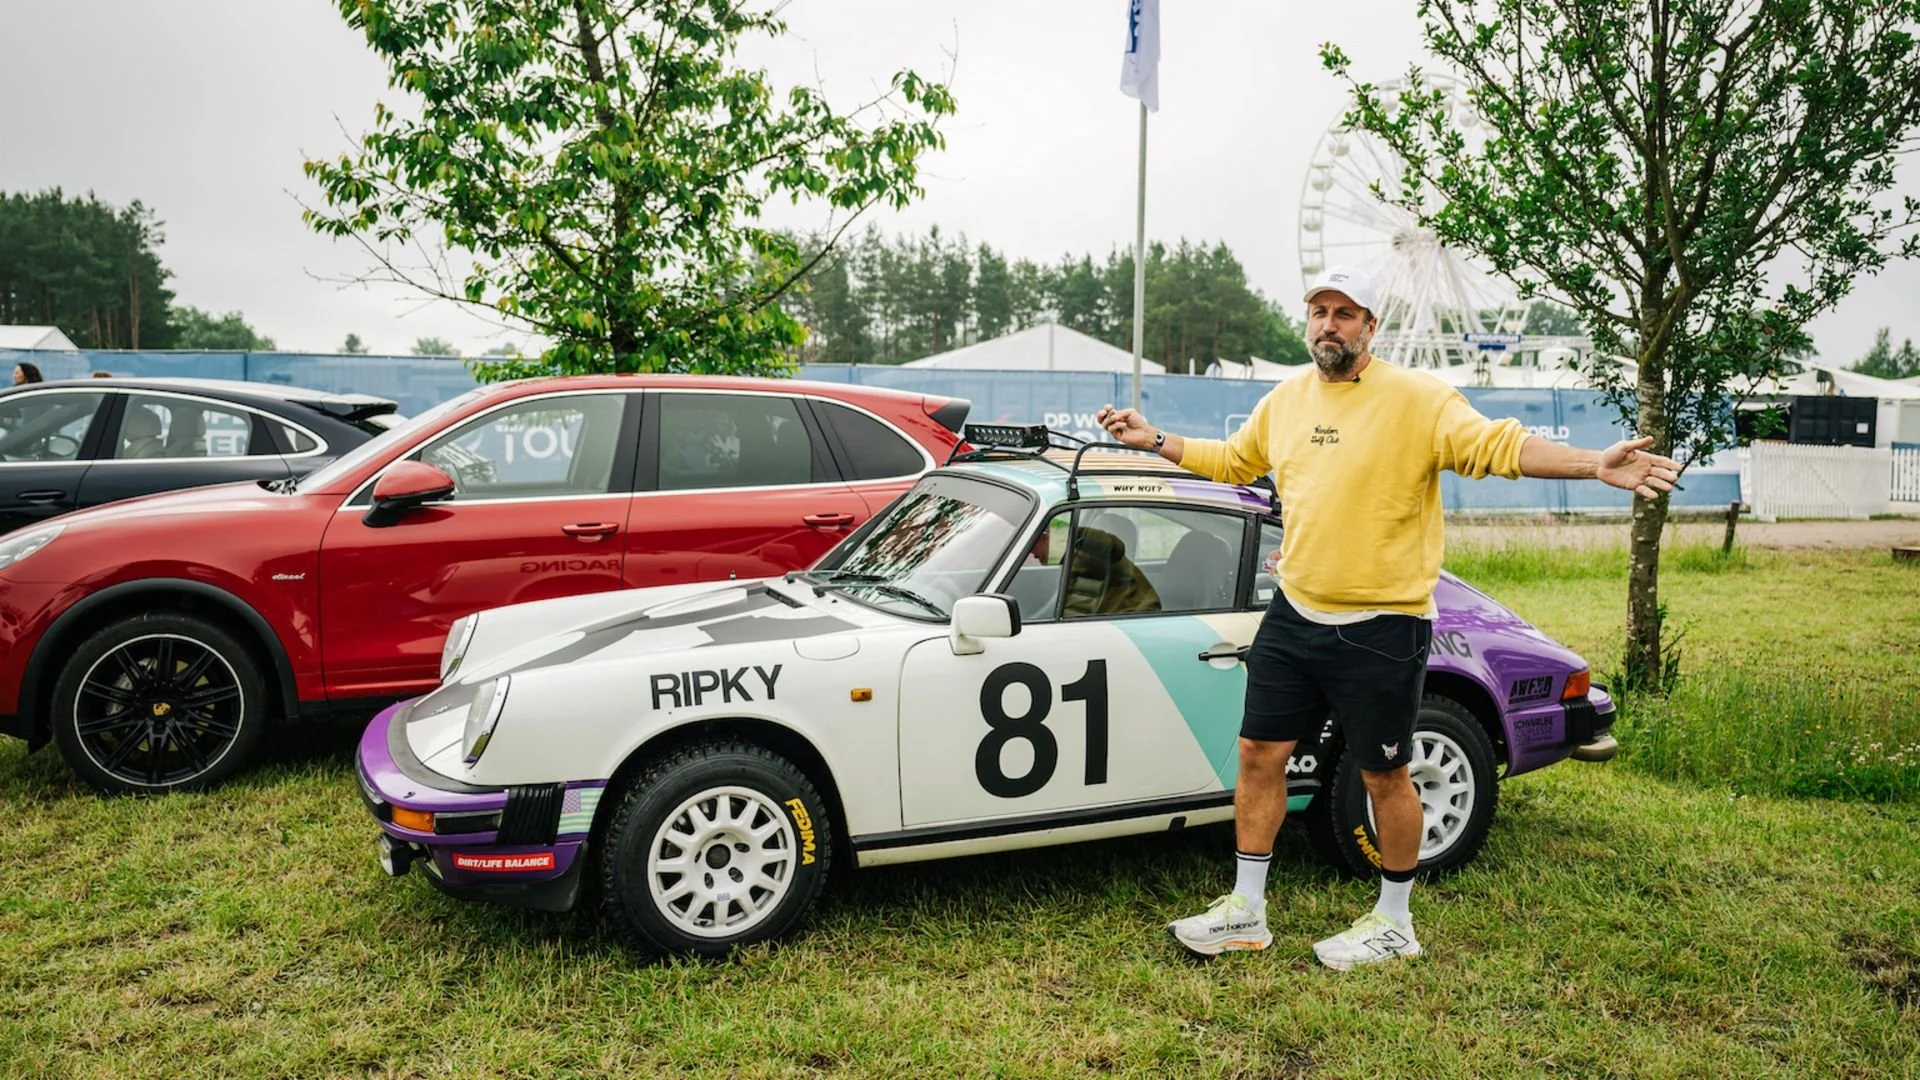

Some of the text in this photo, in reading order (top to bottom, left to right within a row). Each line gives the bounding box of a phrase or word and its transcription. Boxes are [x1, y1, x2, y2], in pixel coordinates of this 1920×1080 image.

[1044, 412, 1072, 428] DP
[1523, 425, 1570, 440] ORLD
[1138, 485, 1162, 493] NOT?
[650, 663, 783, 710] RIPKY
[975, 658, 1109, 799] 81
[784, 798, 816, 866] FEDIMA
[458, 857, 550, 868] DIRT/LIFE BALANCE
